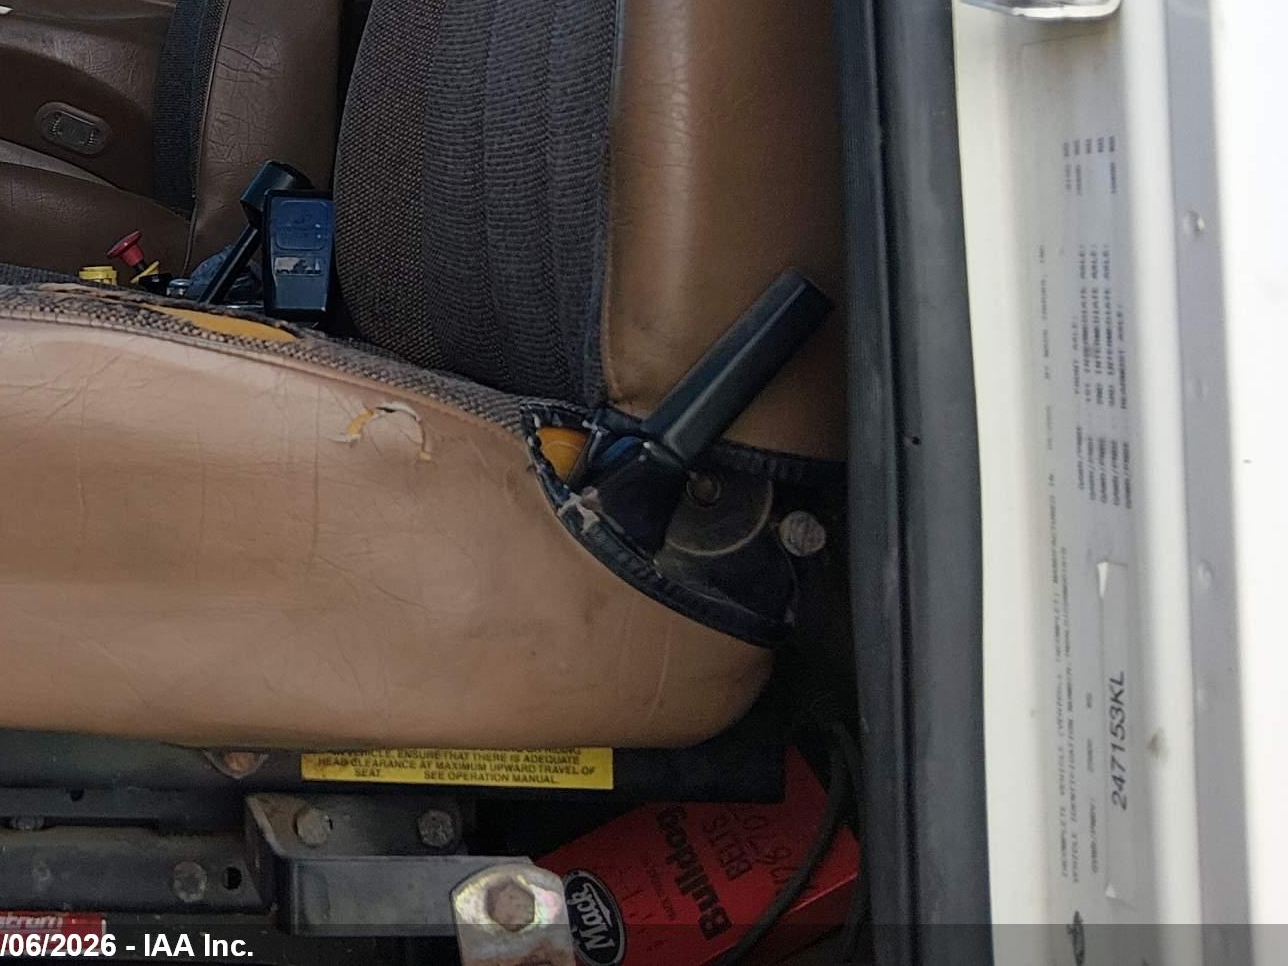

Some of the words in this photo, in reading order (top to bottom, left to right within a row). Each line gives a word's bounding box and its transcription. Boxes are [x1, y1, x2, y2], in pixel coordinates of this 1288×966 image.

[1108, 670, 1127, 809] 247153KL
[350, 757, 417, 770] CLEARANCE
[420, 759, 433, 770] AT
[436, 760, 487, 772] MAXIMUM
[489, 762, 536, 774] UPWARD
[538, 764, 579, 775] TRAVEL
[580, 765, 596, 776] OF
[473, 752, 507, 762] THERE
[523, 753, 580, 765] ADEQUATE
[424, 769, 445, 780] SEE
[447, 770, 510, 782] OPERATION
[568, 883, 616, 951] Mack
